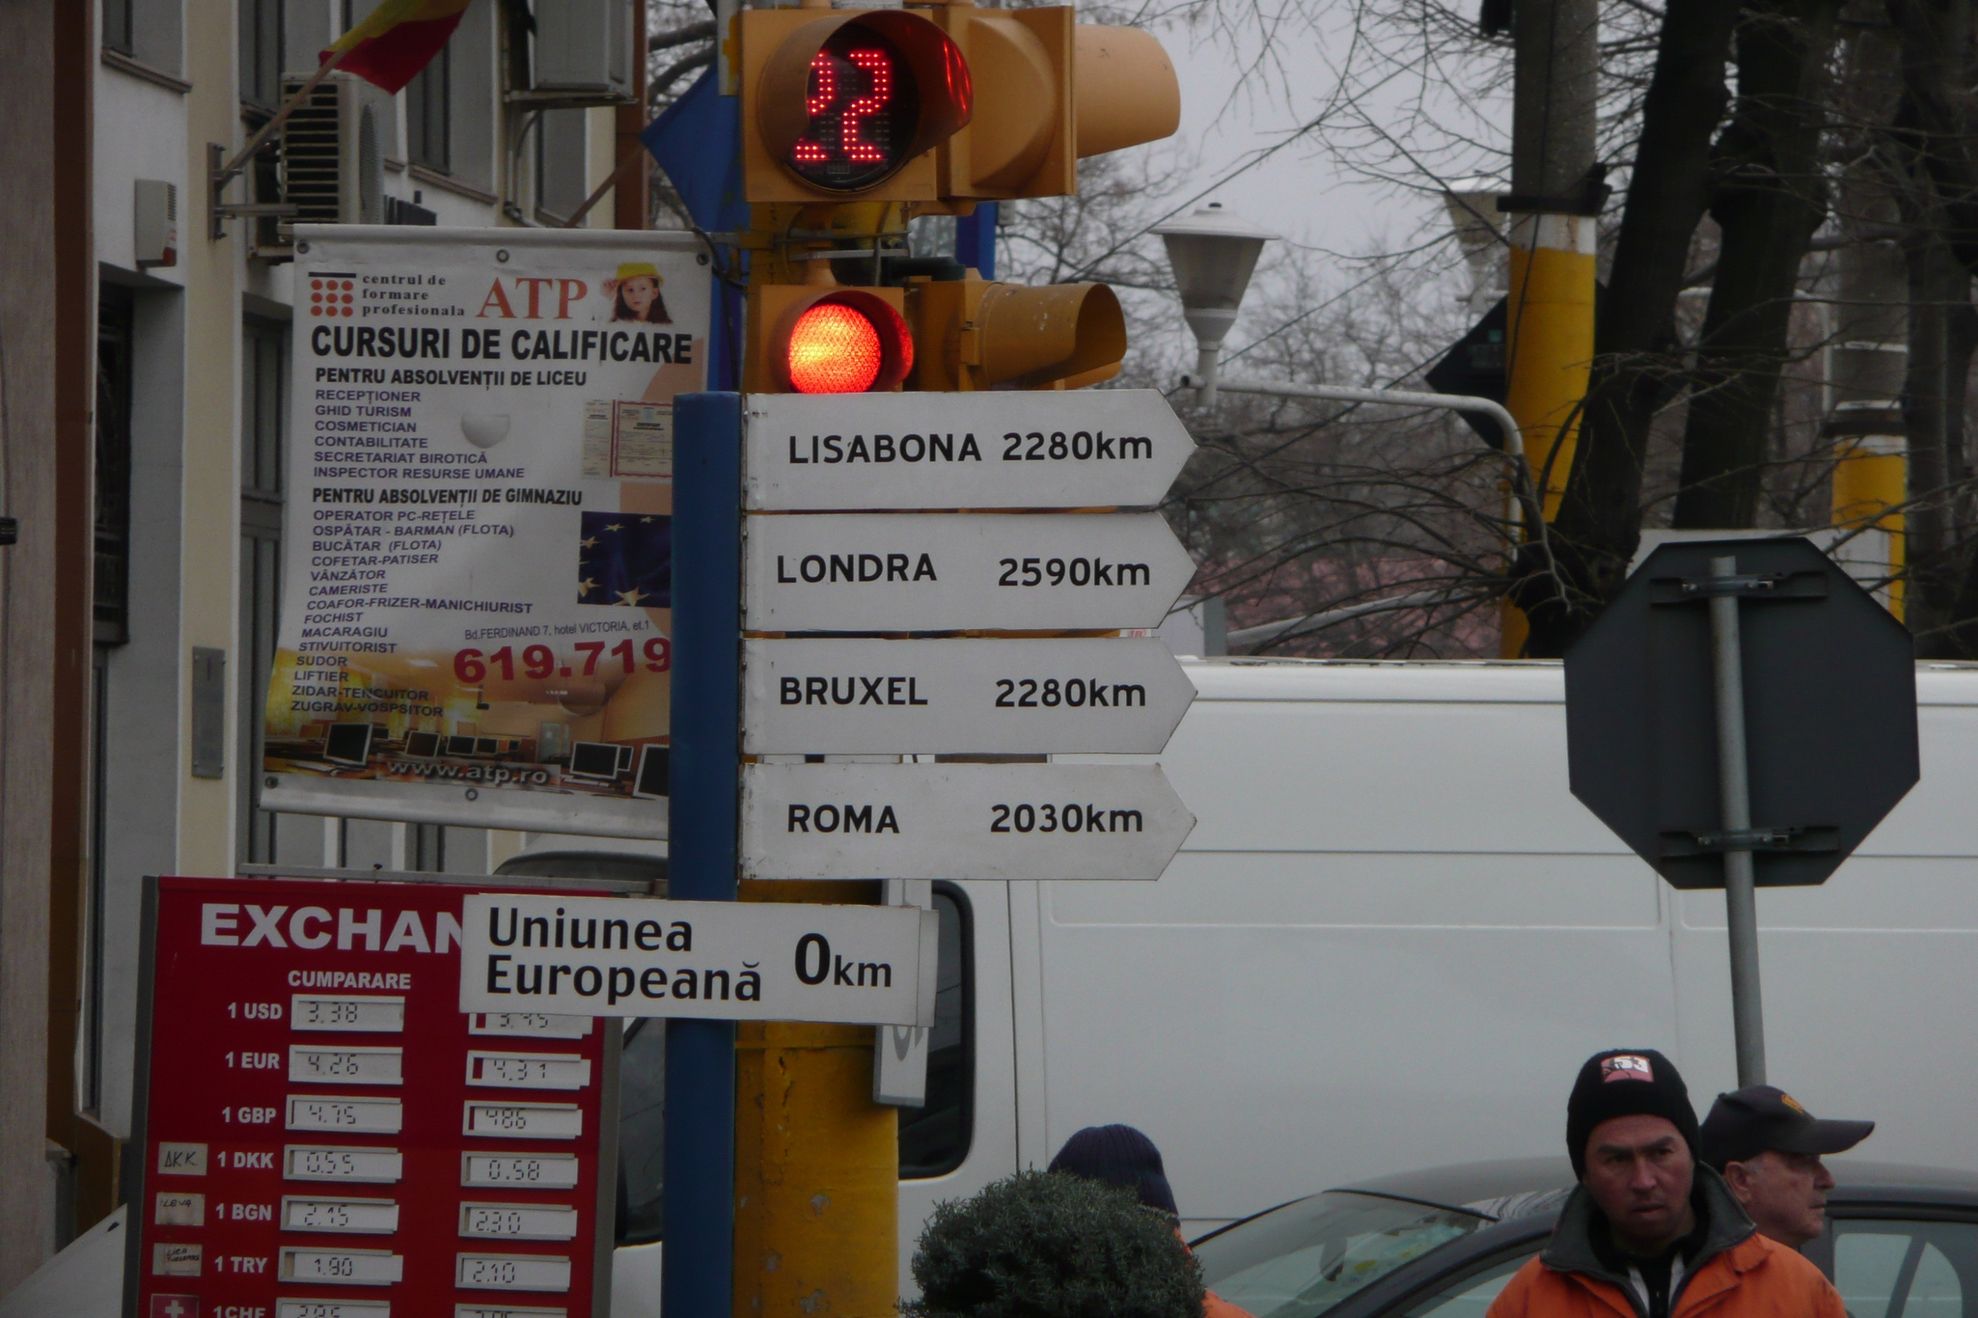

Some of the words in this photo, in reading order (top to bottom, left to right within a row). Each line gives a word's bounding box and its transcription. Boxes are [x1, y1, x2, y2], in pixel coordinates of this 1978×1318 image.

[362, 274, 422, 285] centrul
[428, 274, 446, 286] de
[362, 288, 429, 300] formare
[475, 276, 588, 320] ATP
[362, 304, 465, 317] profesionala
[311, 324, 450, 359] CURSURI
[461, 328, 501, 360] DE
[511, 328, 692, 364] CALIFICARE
[315, 367, 386, 384] PENTRU
[391, 369, 505, 391] ABSOLVENȚII
[511, 371, 532, 386] DE
[537, 370, 587, 386] LICEU
[315, 404, 352, 417] GHID
[356, 406, 412, 418] TURISM
[314, 420, 417, 433] COSMETICIAN
[314, 436, 428, 449] CONTABILITATE
[788, 433, 982, 464] LISABONA
[1002, 431, 1153, 461] 2280km
[314, 451, 415, 464] SECRETARIAT
[420, 451, 488, 464] BIROTICĂ
[313, 466, 398, 479] INSPECTOR
[402, 467, 471, 480] RESURSE
[475, 467, 525, 479] UMANE
[312, 487, 374, 503] PENTRU
[379, 488, 477, 508] ABSOLVENȚII
[482, 489, 501, 504] DE
[506, 488, 583, 506] GIMNAZIU
[313, 510, 393, 521] OPERATOR
[394, 524, 455, 537] BARMAN
[458, 524, 515, 538] (FLOTA)
[388, 539, 442, 554] (FLOTA)
[312, 554, 439, 567] COFETAR-PATISER
[777, 553, 937, 584] LONDRA
[998, 556, 1150, 587] 2590km
[309, 583, 388, 597] CAMERISTE
[307, 597, 533, 614] COAFOR-FRIZER-MANICHIURIST
[304, 612, 364, 625] FOCHIST
[301, 626, 389, 638] MACARAGIU
[464, 625, 541, 641] Bd.FERDINAND
[554, 624, 577, 636] hotel
[298, 641, 398, 654] STIVUITORIST
[296, 655, 348, 667] SUDOR
[453, 637, 672, 684] 619.719
[294, 671, 349, 682] LIFTIER
[292, 685, 430, 701] ZIDAR-TENCUITOR
[780, 677, 929, 706] BRUXEL
[995, 677, 1146, 708] 2280km
[386, 760, 548, 785] www.atp.ro
[787, 803, 901, 834] ROMA
[990, 803, 1144, 833] 2030km
[200, 902, 463, 955] EXCHAN
[488, 906, 693, 952] Uniunea
[794, 932, 892, 988] 0km
[287, 970, 411, 990] CUMPARARE
[486, 954, 762, 1005] Europeană
[227, 1002, 237, 1019] 1
[244, 1003, 283, 1020] USD
[308, 1001, 358, 1024] 3.38
[225, 1052, 235, 1069] 1
[241, 1053, 280, 1069] EUR
[308, 1053, 358, 1075] 4.26
[493, 1059, 547, 1081] 4.31
[222, 1106, 231, 1123] 1
[238, 1107, 277, 1124] GBP
[217, 1151, 226, 1169] 1
[233, 1152, 274, 1169] DKK
[489, 1159, 541, 1181] 0.58
[215, 1203, 225, 1220] 1
[231, 1204, 272, 1221] BGN
[214, 1255, 224, 1273] 1
[230, 1256, 269, 1274] TRY
